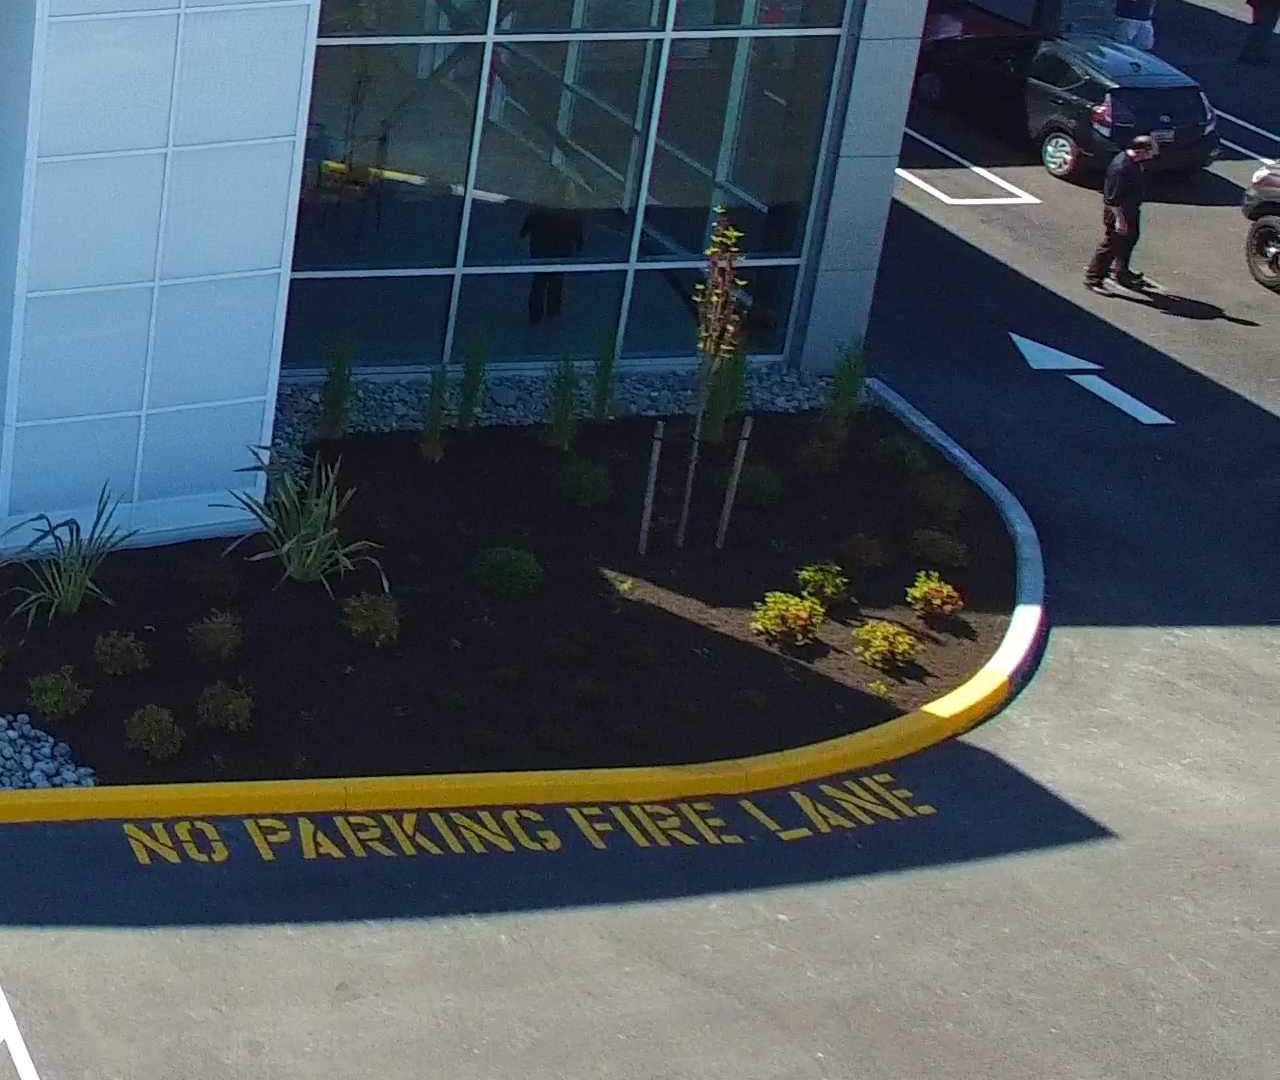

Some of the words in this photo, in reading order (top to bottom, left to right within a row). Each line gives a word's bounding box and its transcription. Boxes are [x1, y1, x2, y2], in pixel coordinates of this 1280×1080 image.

[123, 820, 228, 865] NO
[240, 809, 561, 861] PARKING
[566, 803, 744, 849] FIRE
[739, 773, 938, 841] LANE
